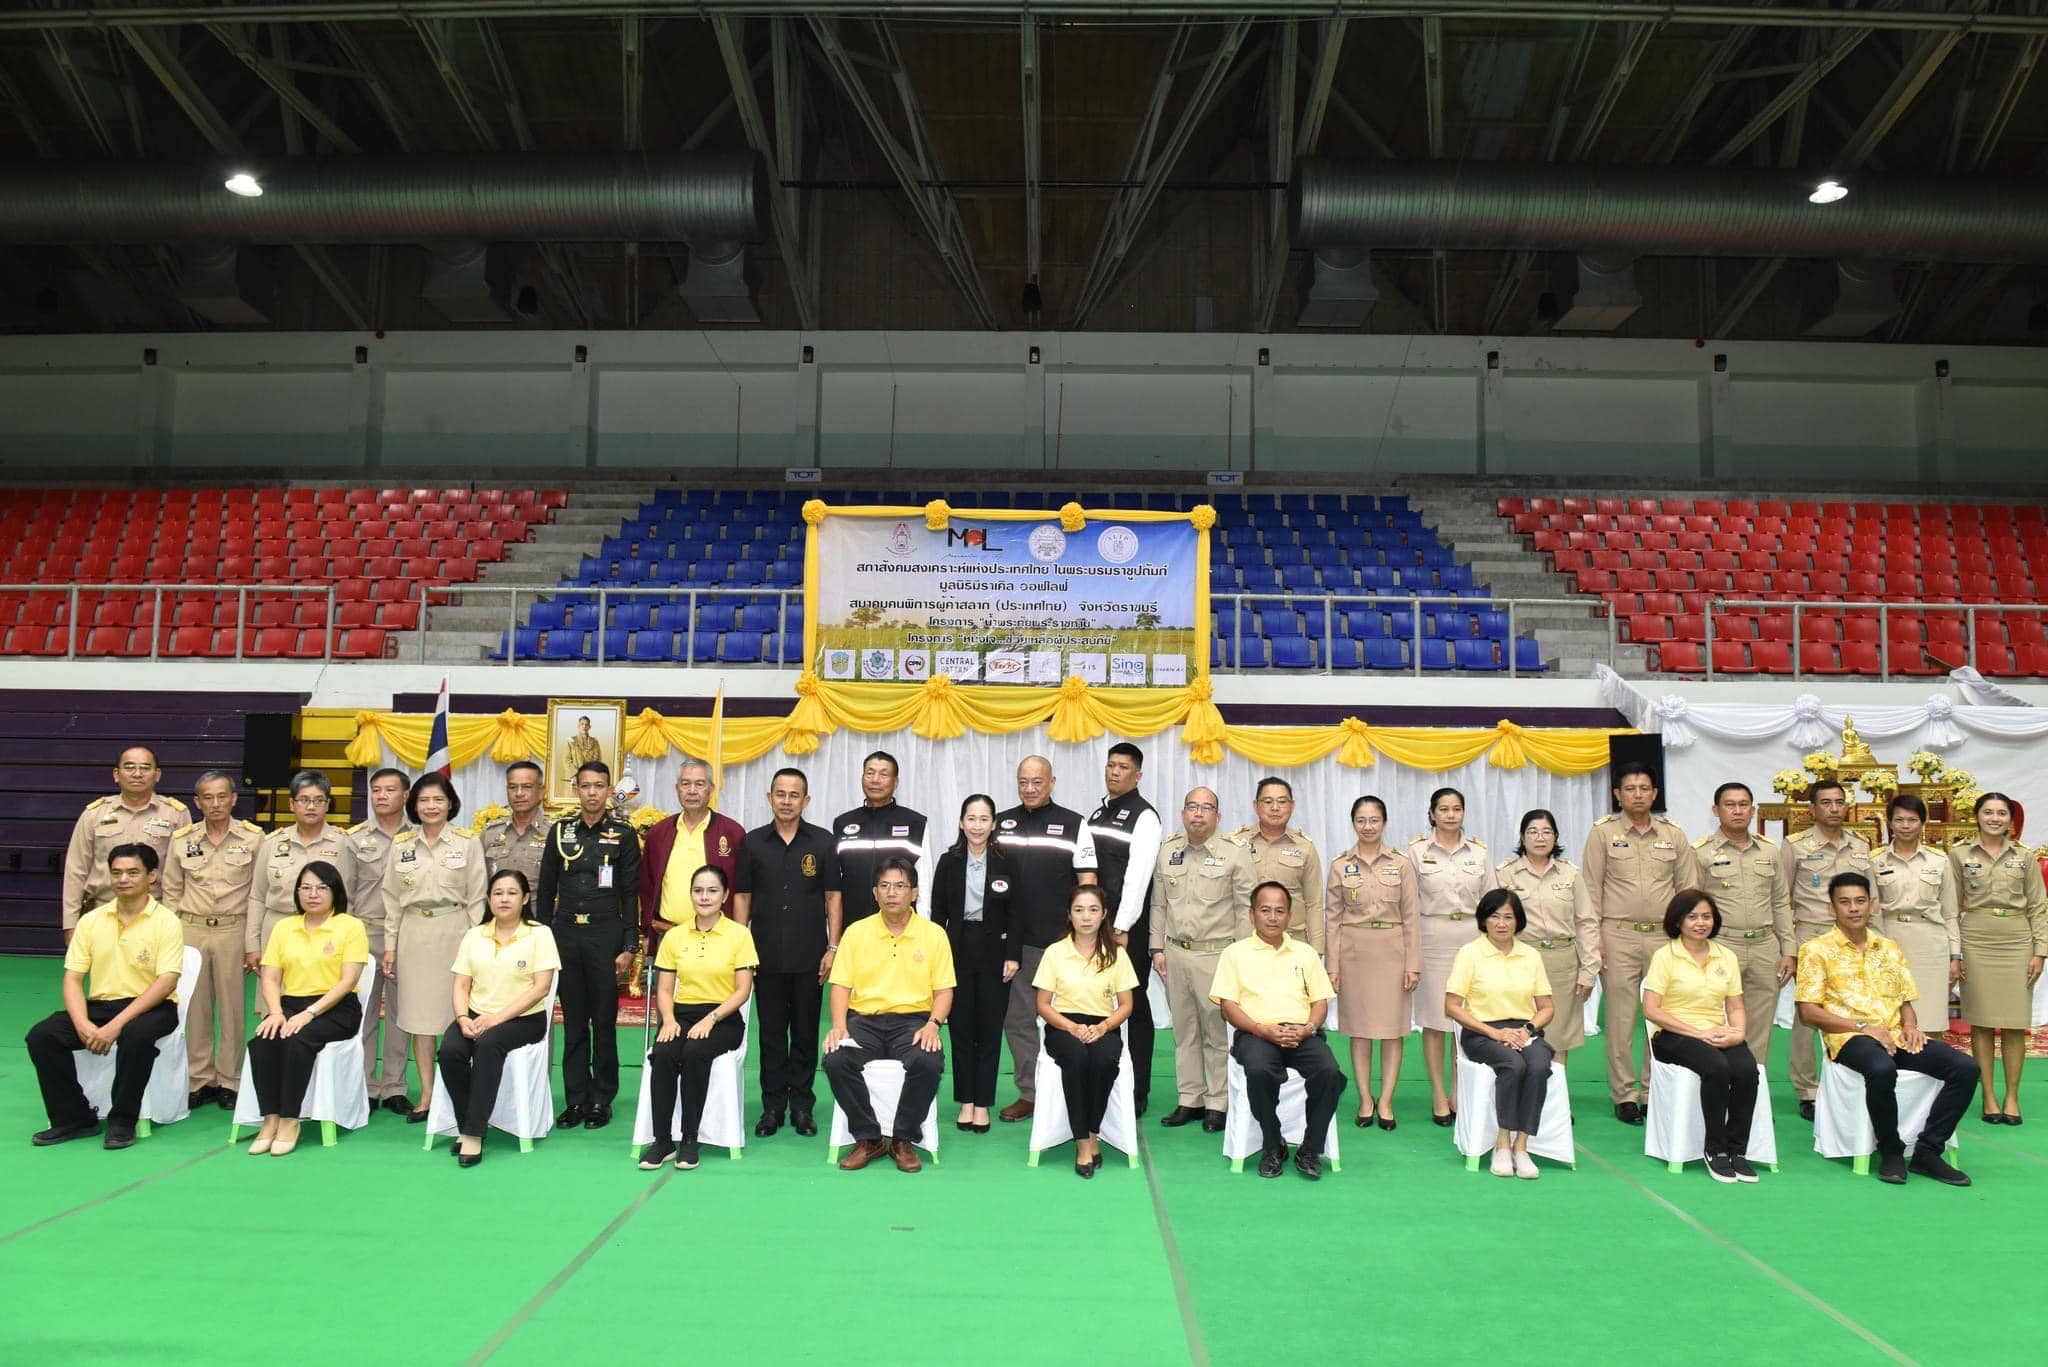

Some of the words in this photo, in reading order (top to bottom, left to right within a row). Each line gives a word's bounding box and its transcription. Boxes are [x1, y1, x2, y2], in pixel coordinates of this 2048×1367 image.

[995, 598, 1067, 612] (ประเทศไทย)
[1079, 600, 1158, 614] จังหวัดราชบุรี
[928, 615, 974, 627] โครงการ
[907, 632, 953, 644] โครงการ
[383, 636, 399, 659] B
[940, 657, 975, 665] CENTRAL
